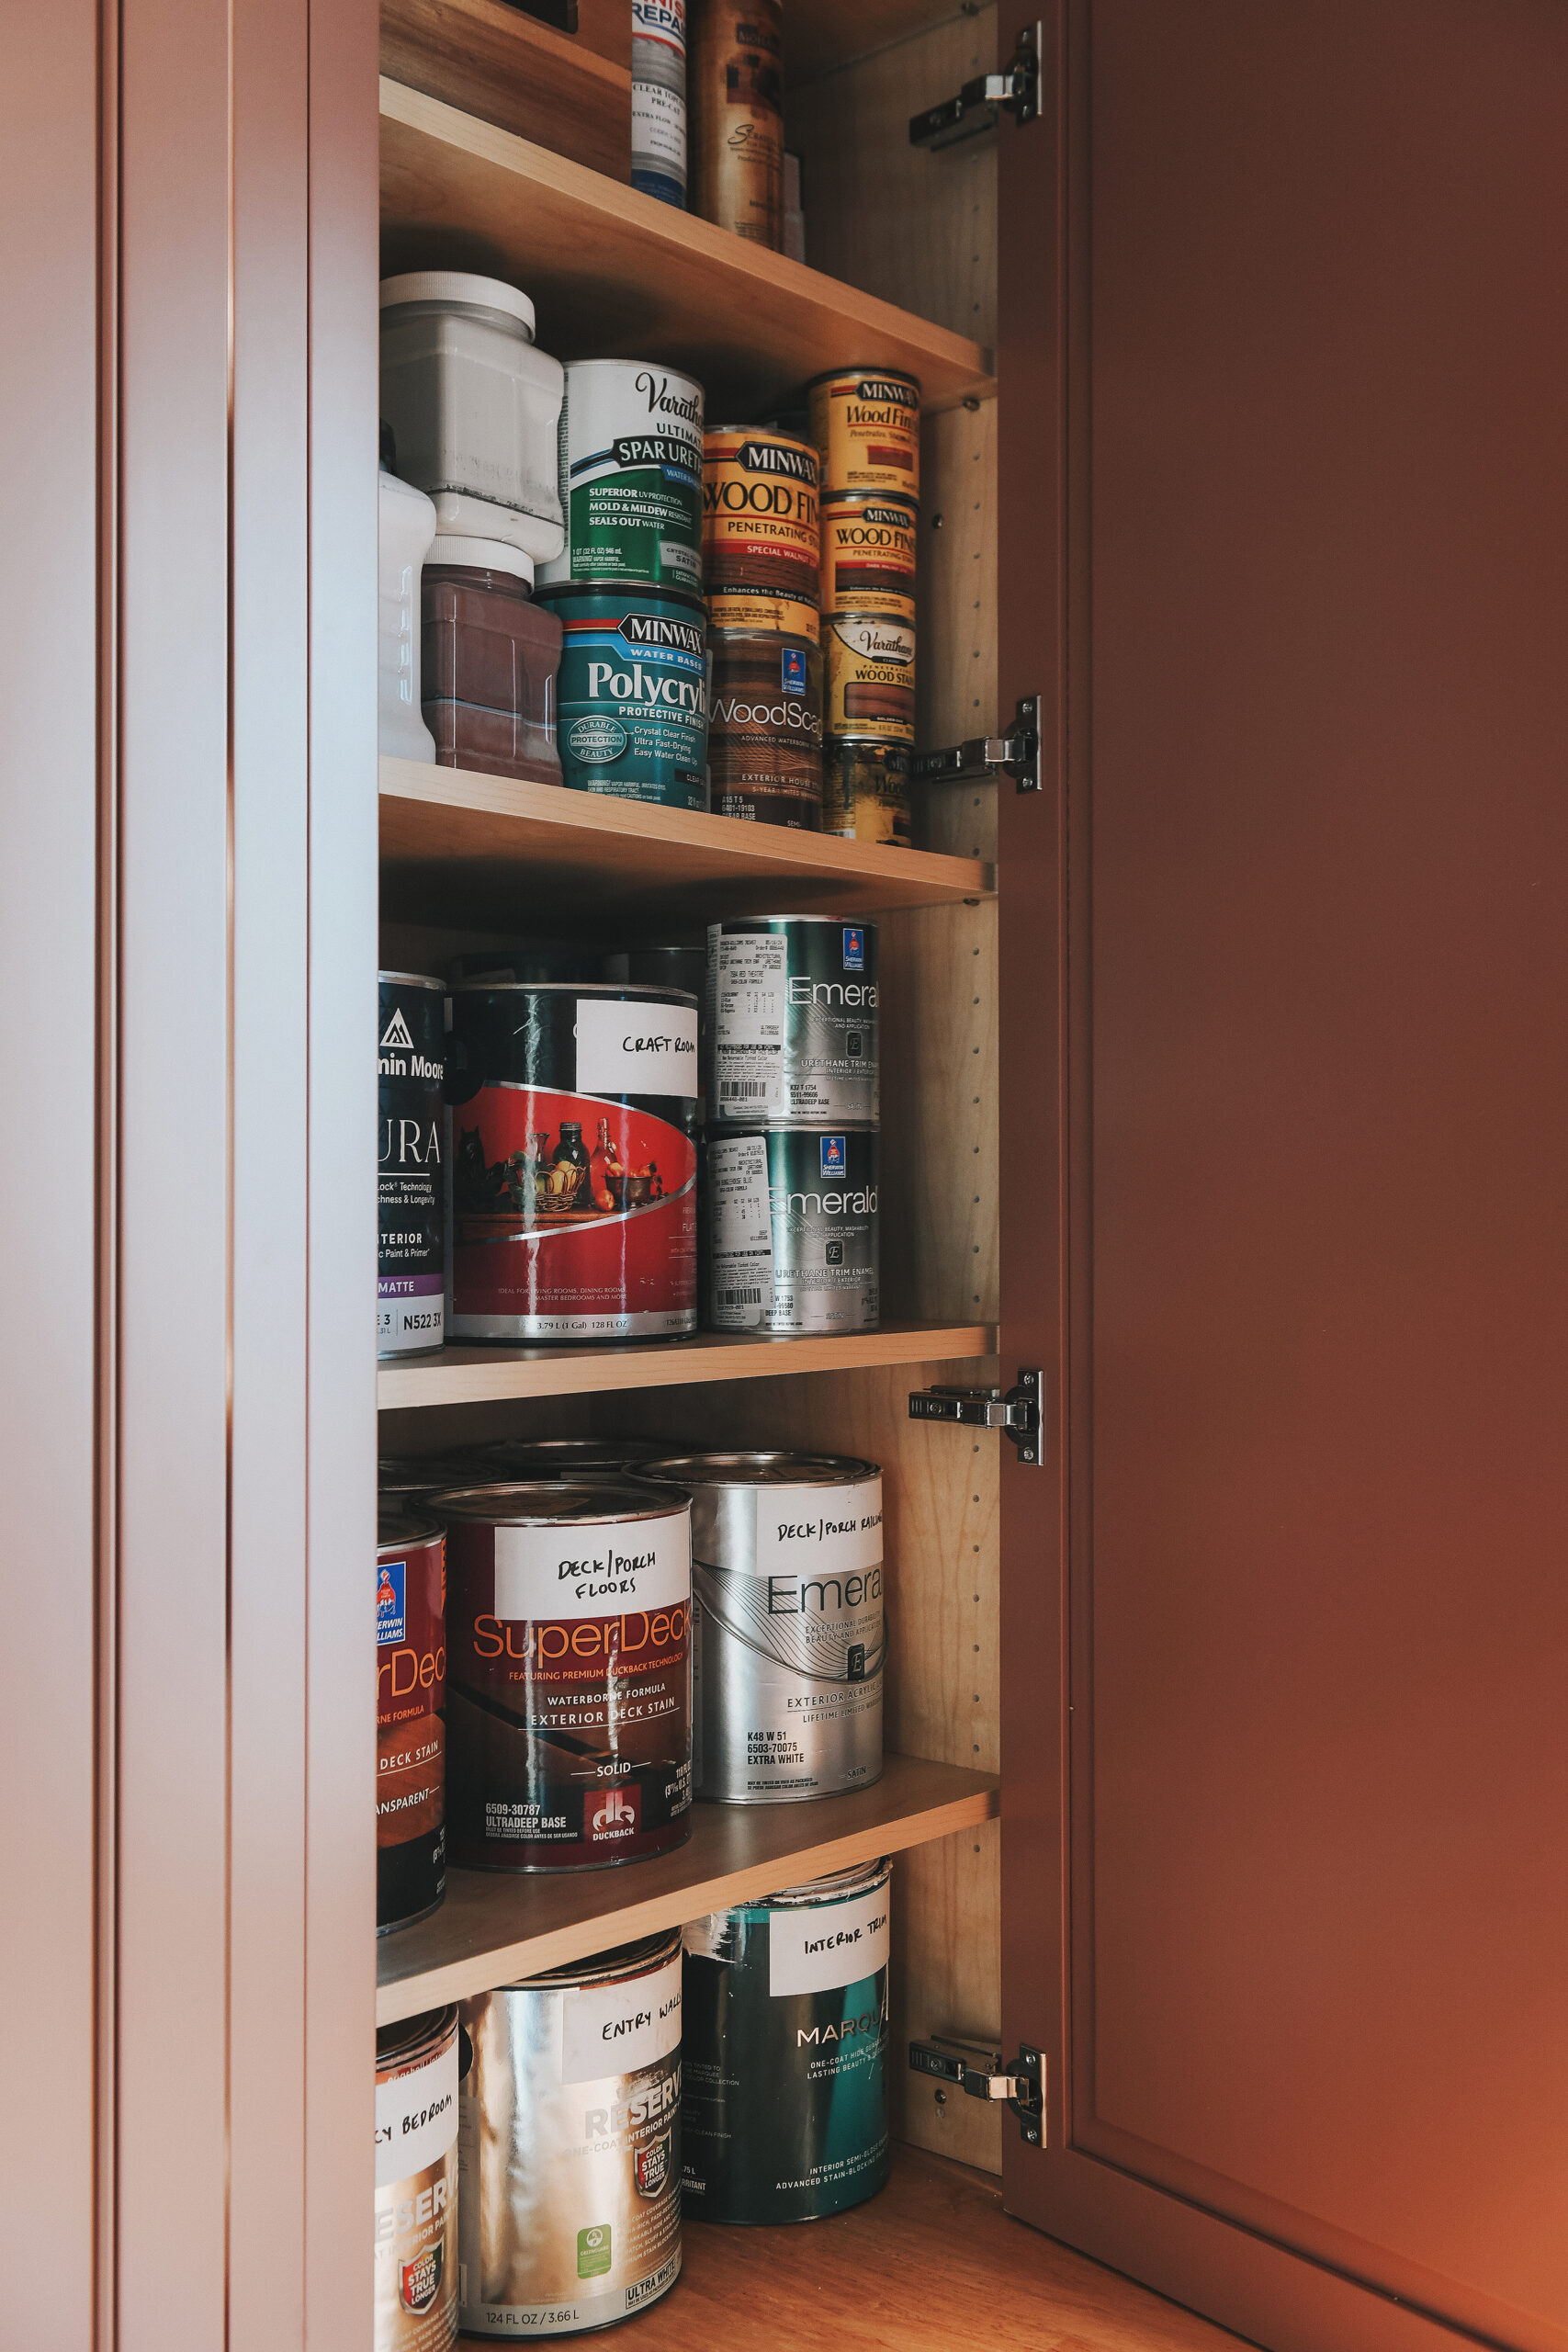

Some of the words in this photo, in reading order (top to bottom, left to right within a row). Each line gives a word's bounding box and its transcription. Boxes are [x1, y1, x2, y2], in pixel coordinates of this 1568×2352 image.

[618, 440, 666, 461] SPAR
[589, 488, 638, 499] SUPERIOR
[703, 481, 792, 514] WOOD
[589, 503, 621, 512] MOLD
[621, 503, 630, 512] &
[630, 504, 668, 517] MILDEW
[589, 516, 618, 526] SEALS
[619, 517, 642, 527] OUT
[641, 520, 665, 530] WATER
[728, 521, 807, 543] PENETRATING
[836, 527, 891, 546] WOOD
[747, 545, 782, 557] SPECIAL
[630, 649, 674, 662] WATER
[855, 670, 895, 682] WOOD
[618, 706, 682, 723] PROTECTIVE
[577, 720, 616, 733] DURABLE
[634, 727, 661, 736] Crystal
[662, 729, 680, 739] Clear
[634, 737, 653, 746] Ultra
[655, 739, 692, 754] Fast-Drying
[741, 735, 777, 743] ADVANCED
[580, 747, 615, 758] BEAUTY
[634, 749, 652, 758] Easy
[655, 750, 674, 760] Water
[741, 774, 785, 783] EXTERIOR
[622, 1036, 672, 1053] CRAFT
[801, 1059, 849, 1068] URETHANE
[400, 1182, 432, 1193] Technology
[410, 1195, 435, 1205] Longevity
[386, 1249, 404, 1258] Paint
[405, 1249, 410, 1257] &
[774, 1269, 828, 1279] URETHANE
[830, 1268, 851, 1277] TRIM
[378, 1281, 415, 1293] MATTE
[403, 1313, 432, 1330] N522
[536, 1321, 554, 1329] 3.79
[561, 1321, 569, 1330] (1
[570, 1321, 587, 1330] Gal)
[615, 1320, 627, 1329] OZ
[558, 1549, 656, 1580] DECK/PORCH
[575, 1577, 636, 1599] FLOORS
[806, 1620, 856, 1634] EXCEPTIONAL
[509, 1672, 560, 1680] FEATURING
[562, 1669, 603, 1679] PREMIUM
[649, 1652, 683, 1669] TECHNOLOGY
[547, 1691, 623, 1706] WATERBORNE
[626, 1682, 666, 1699] FORMULA
[787, 1691, 844, 1708] EXTERIOR
[393, 1704, 424, 1721] FORMULA
[531, 1712, 604, 1725] EXTERIOR
[610, 1704, 643, 1720] DECK
[648, 1696, 675, 1714] STAIN
[803, 1711, 839, 1724] LIFETIME
[747, 1732, 764, 1741] K48
[766, 1731, 775, 1741] W
[777, 1731, 787, 1741] 51
[379, 1751, 412, 1770] DECK
[415, 1739, 438, 1760] STAIN
[747, 1742, 797, 1754] 6503-70075
[747, 1755, 776, 1765] EXTRA
[778, 1753, 805, 1764] WHITE
[596, 1762, 631, 1777] SOLID
[847, 1766, 866, 1780] SATIN
[485, 1803, 541, 1816] 6509-30787
[485, 1815, 538, 1828] ULTRADEEP
[541, 1816, 567, 1828] BASE
[592, 1827, 635, 1841] DUCKBACK
[804, 1928, 863, 1955] INTERIOR
[866, 1915, 887, 1935] TRIM
[602, 2011, 652, 2041] ENTRY
[807, 2066, 840, 2080] LASTING
[842, 2057, 867, 2072] BEAUTY
[810, 2053, 849, 2069] ONE-COAT
[402, 2094, 453, 2134] BEDROOM
[625, 2118, 663, 2143] INTERIOR
[646, 2143, 663, 2158] COLOR
[641, 2150, 665, 2172] STAYS
[809, 2160, 844, 2176] INTERIOR
[643, 2161, 665, 2181] TRUE
[644, 2172, 665, 2188] LONGER
[775, 2177, 821, 2189] ADVANCED
[412, 2254, 434, 2271] COLOR
[408, 2261, 437, 2285] STAYS
[410, 2275, 436, 2297] TRUE
[627, 2277, 656, 2301] ULTRA
[411, 2286, 436, 2305] LONGER
[486, 2312, 503, 2324] 124
[505, 2313, 516, 2325] FL
[521, 2313, 537, 2324] OZ
[548, 2311, 571, 2324] 3.66
[573, 2309, 580, 2321] L
